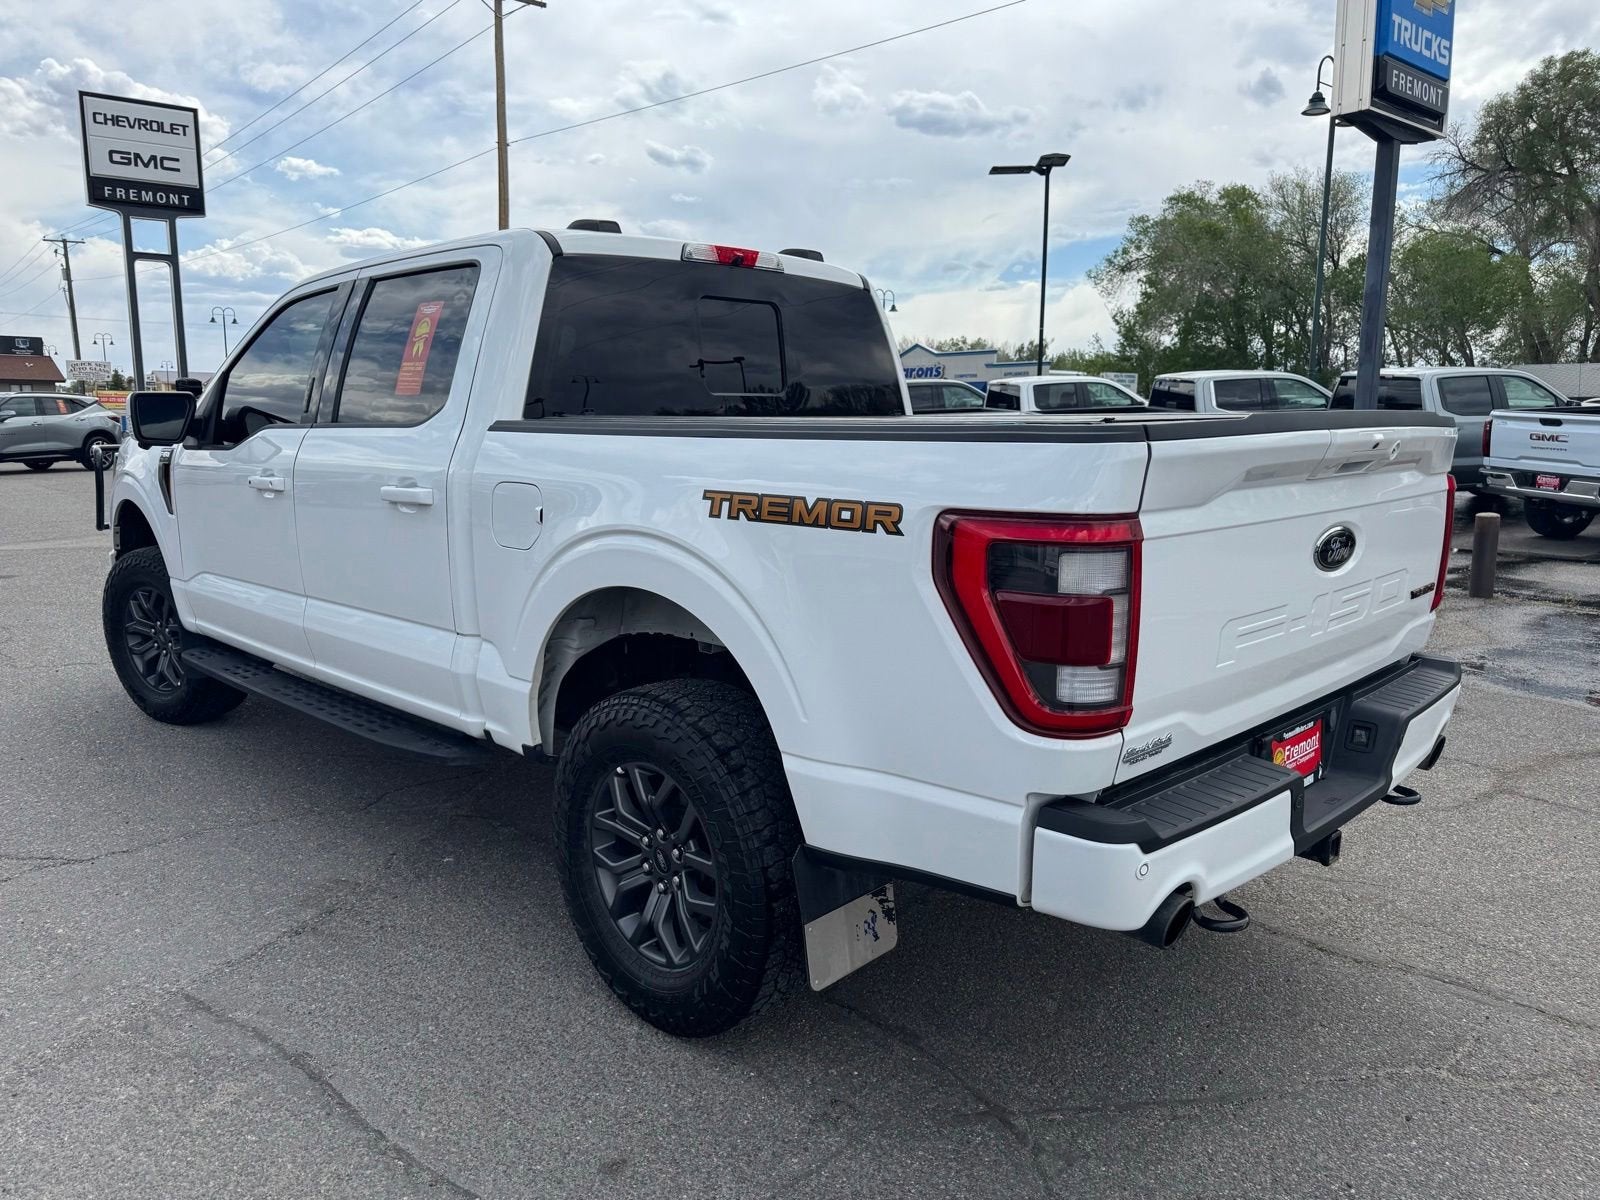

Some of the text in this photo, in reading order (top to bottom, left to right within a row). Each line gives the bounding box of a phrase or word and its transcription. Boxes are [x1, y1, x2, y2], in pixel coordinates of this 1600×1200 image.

[1392, 13, 1450, 66] TRUCKS
[1392, 69, 1443, 106] FREMONT
[92, 111, 189, 136] CHEVROLET
[108, 149, 181, 172] GMC
[104, 186, 190, 206] FREMONT
[1529, 432, 1569, 443] GMC
[702, 489, 905, 536] TREMOR
[1327, 536, 1351, 562] Ford
[1216, 568, 1410, 668] F-150
[1285, 731, 1319, 762] Fremont
